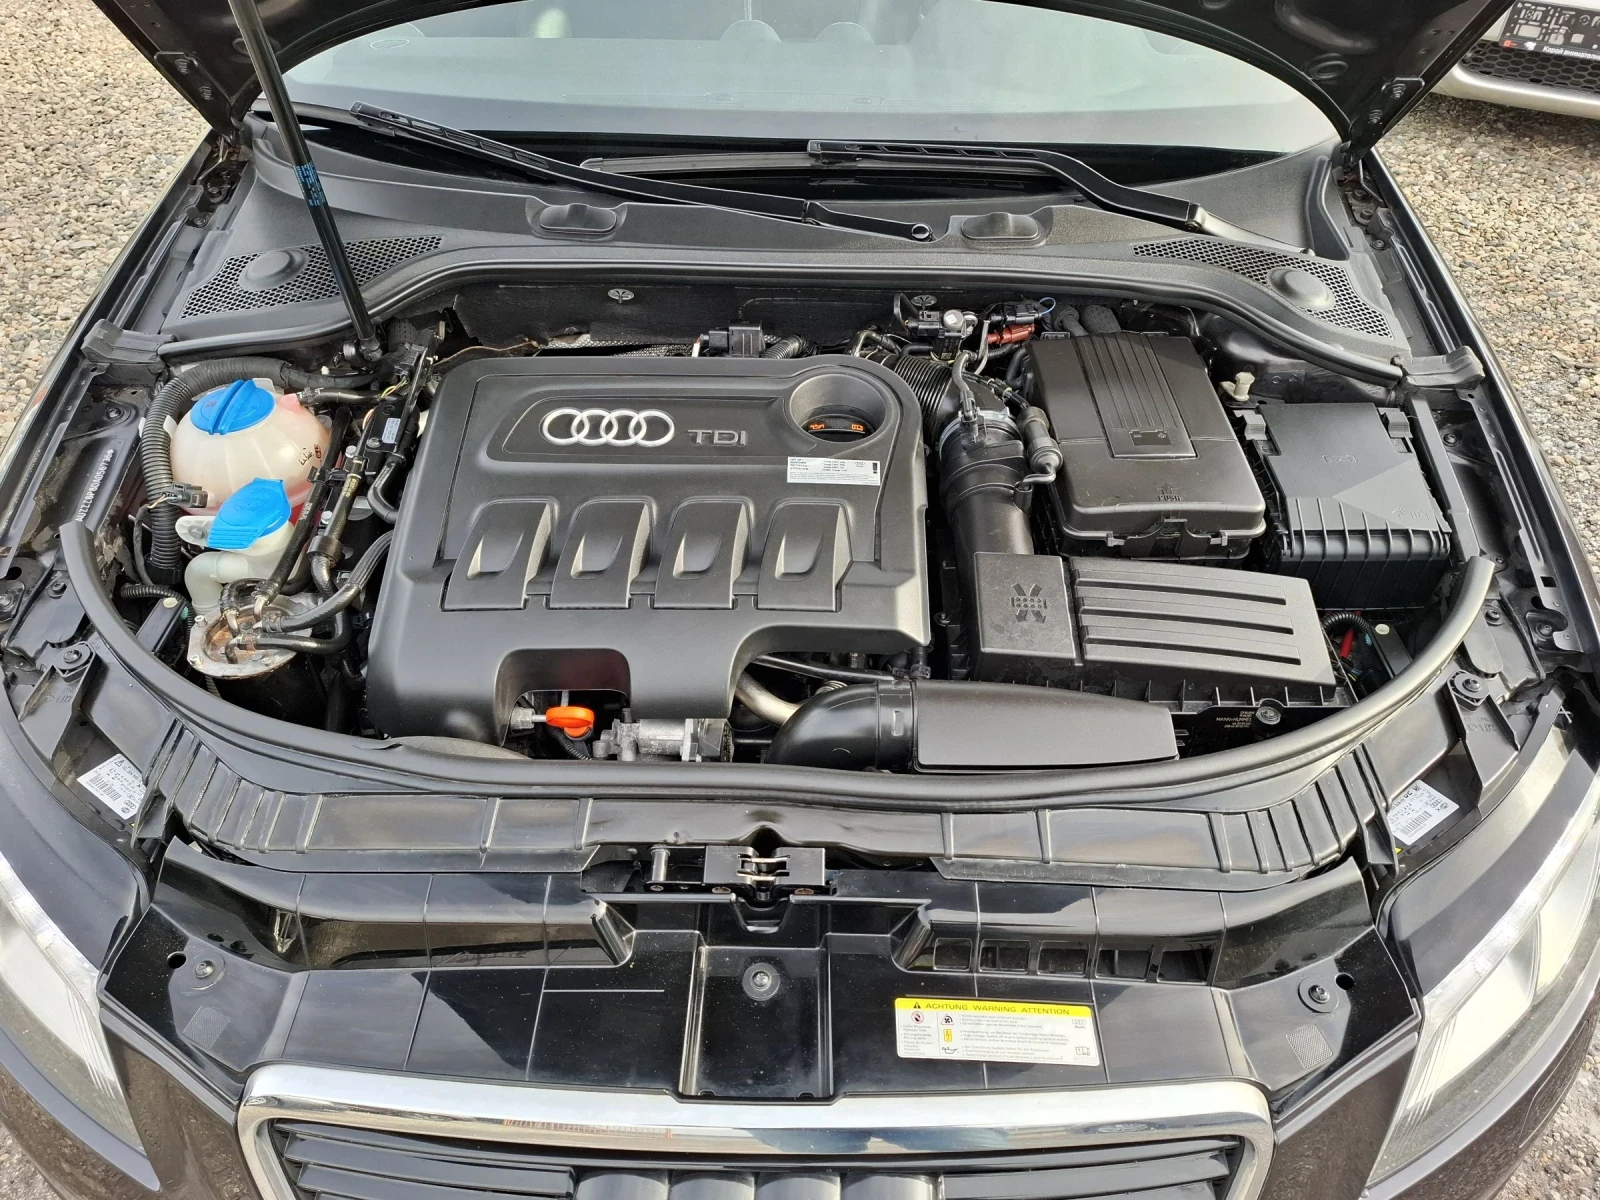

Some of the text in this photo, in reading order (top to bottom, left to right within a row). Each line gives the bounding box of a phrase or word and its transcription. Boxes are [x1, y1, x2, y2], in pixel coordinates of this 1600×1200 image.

[687, 429, 747, 446] TDI
[925, 1002, 1070, 1015] ACHTUNG WARNING ATTENTION
